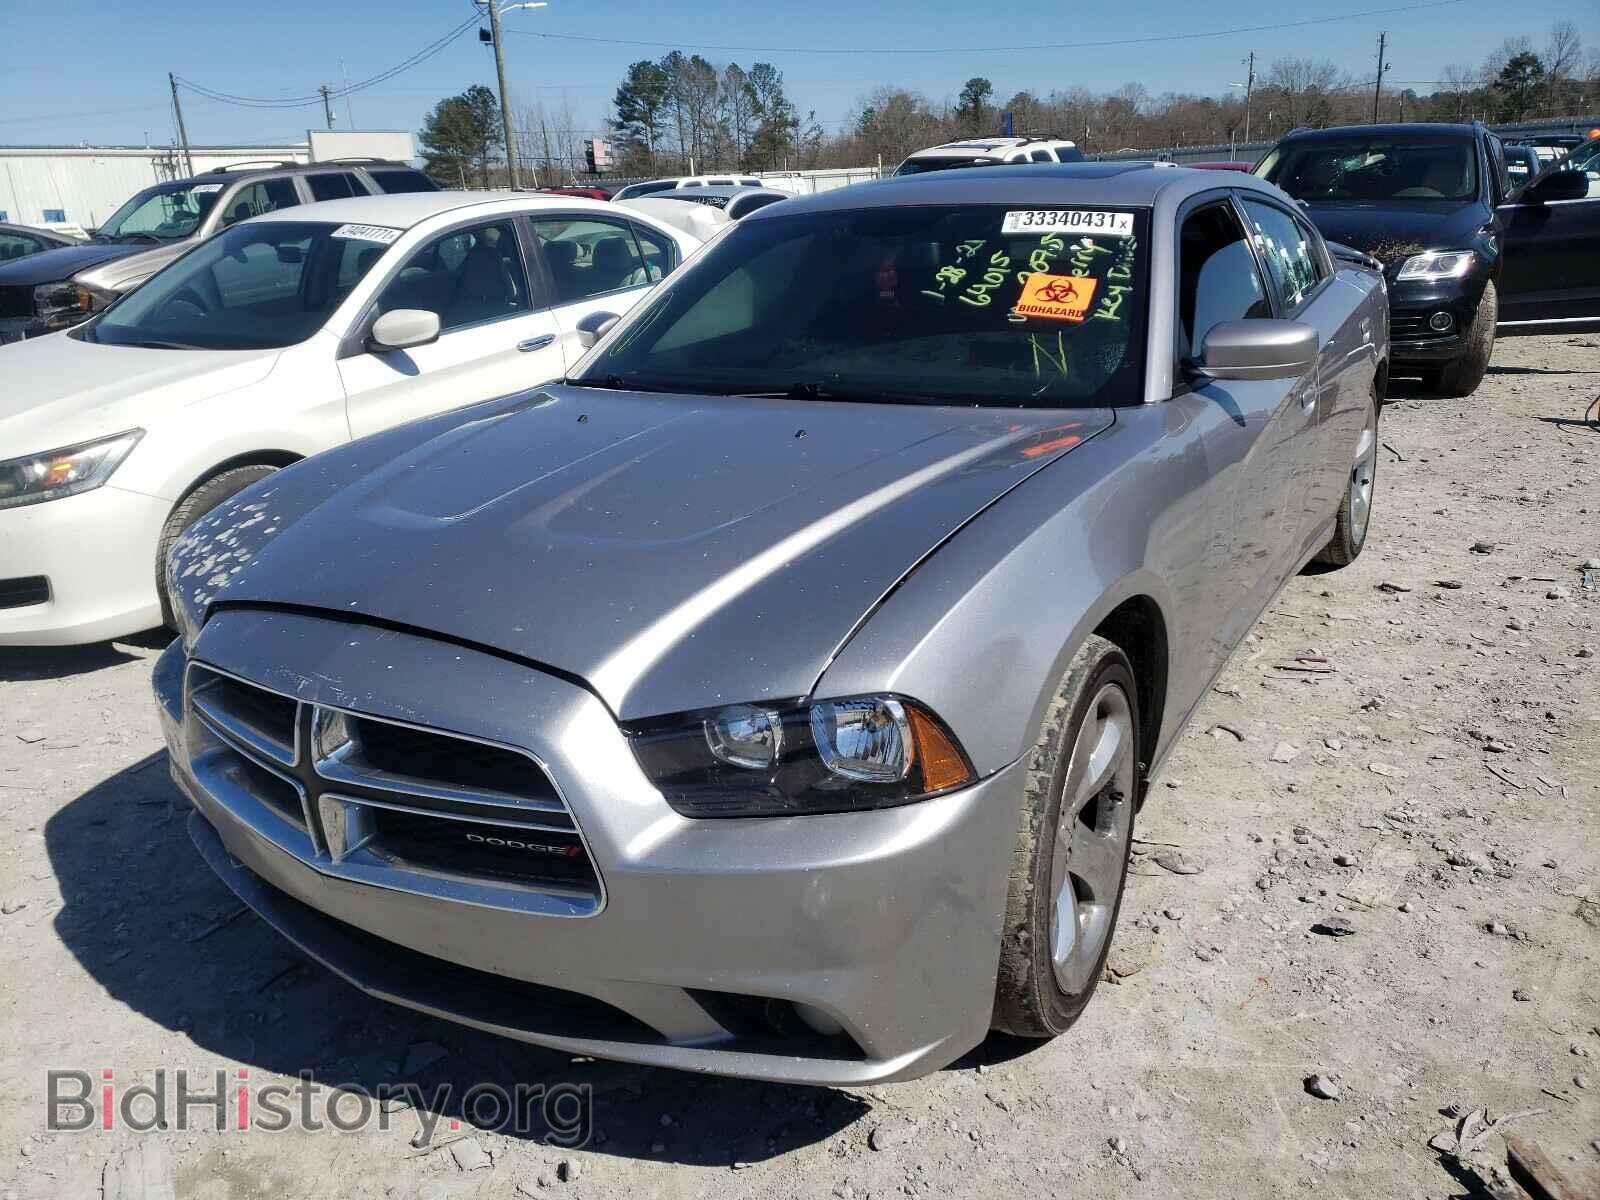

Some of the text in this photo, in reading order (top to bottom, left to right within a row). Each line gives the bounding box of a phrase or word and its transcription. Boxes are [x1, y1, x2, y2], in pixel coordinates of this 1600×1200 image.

[1023, 211, 1116, 228] 33340431
[959, 250, 1012, 306] 64015
[1018, 303, 1083, 319] BIOHAZARD
[465, 833, 568, 856] DODGE
